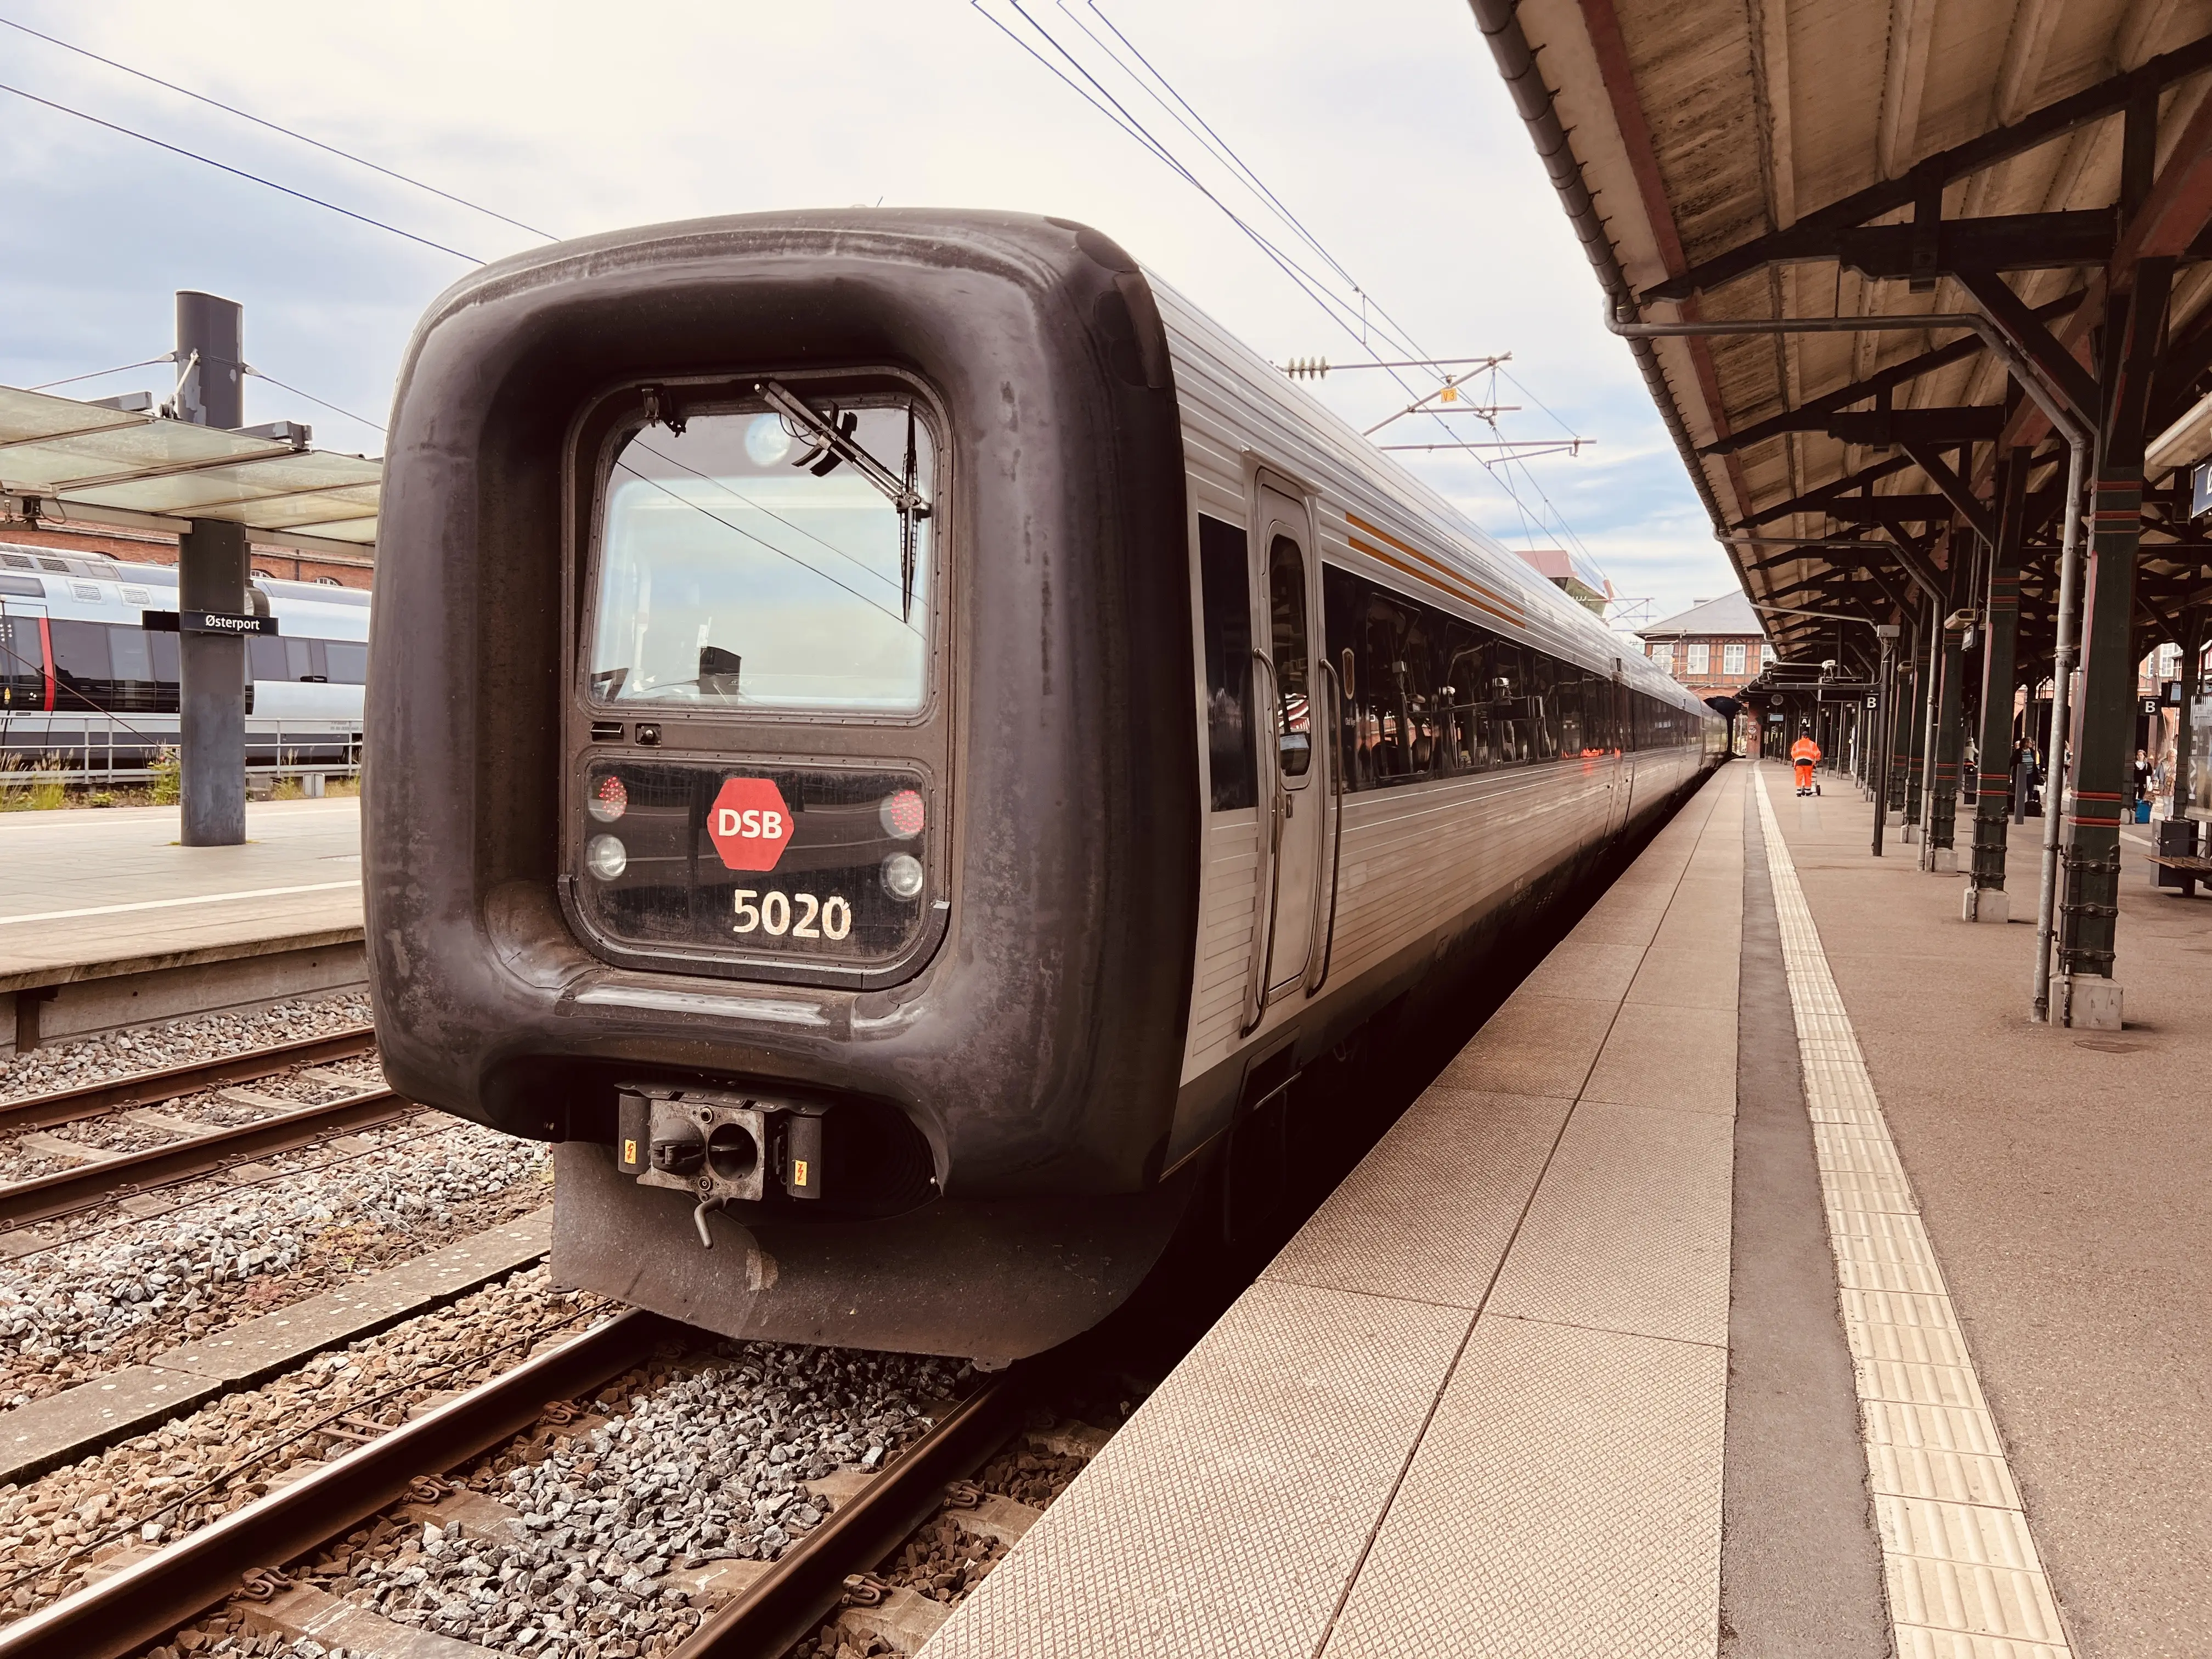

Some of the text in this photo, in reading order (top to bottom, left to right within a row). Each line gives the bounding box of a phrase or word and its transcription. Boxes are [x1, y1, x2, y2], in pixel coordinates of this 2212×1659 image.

[205, 614, 260, 631] Østerport
[1866, 697, 1876, 708] B
[2145, 701, 2155, 713] B
[718, 808, 782, 839] DSB
[733, 889, 851, 940] 5020
